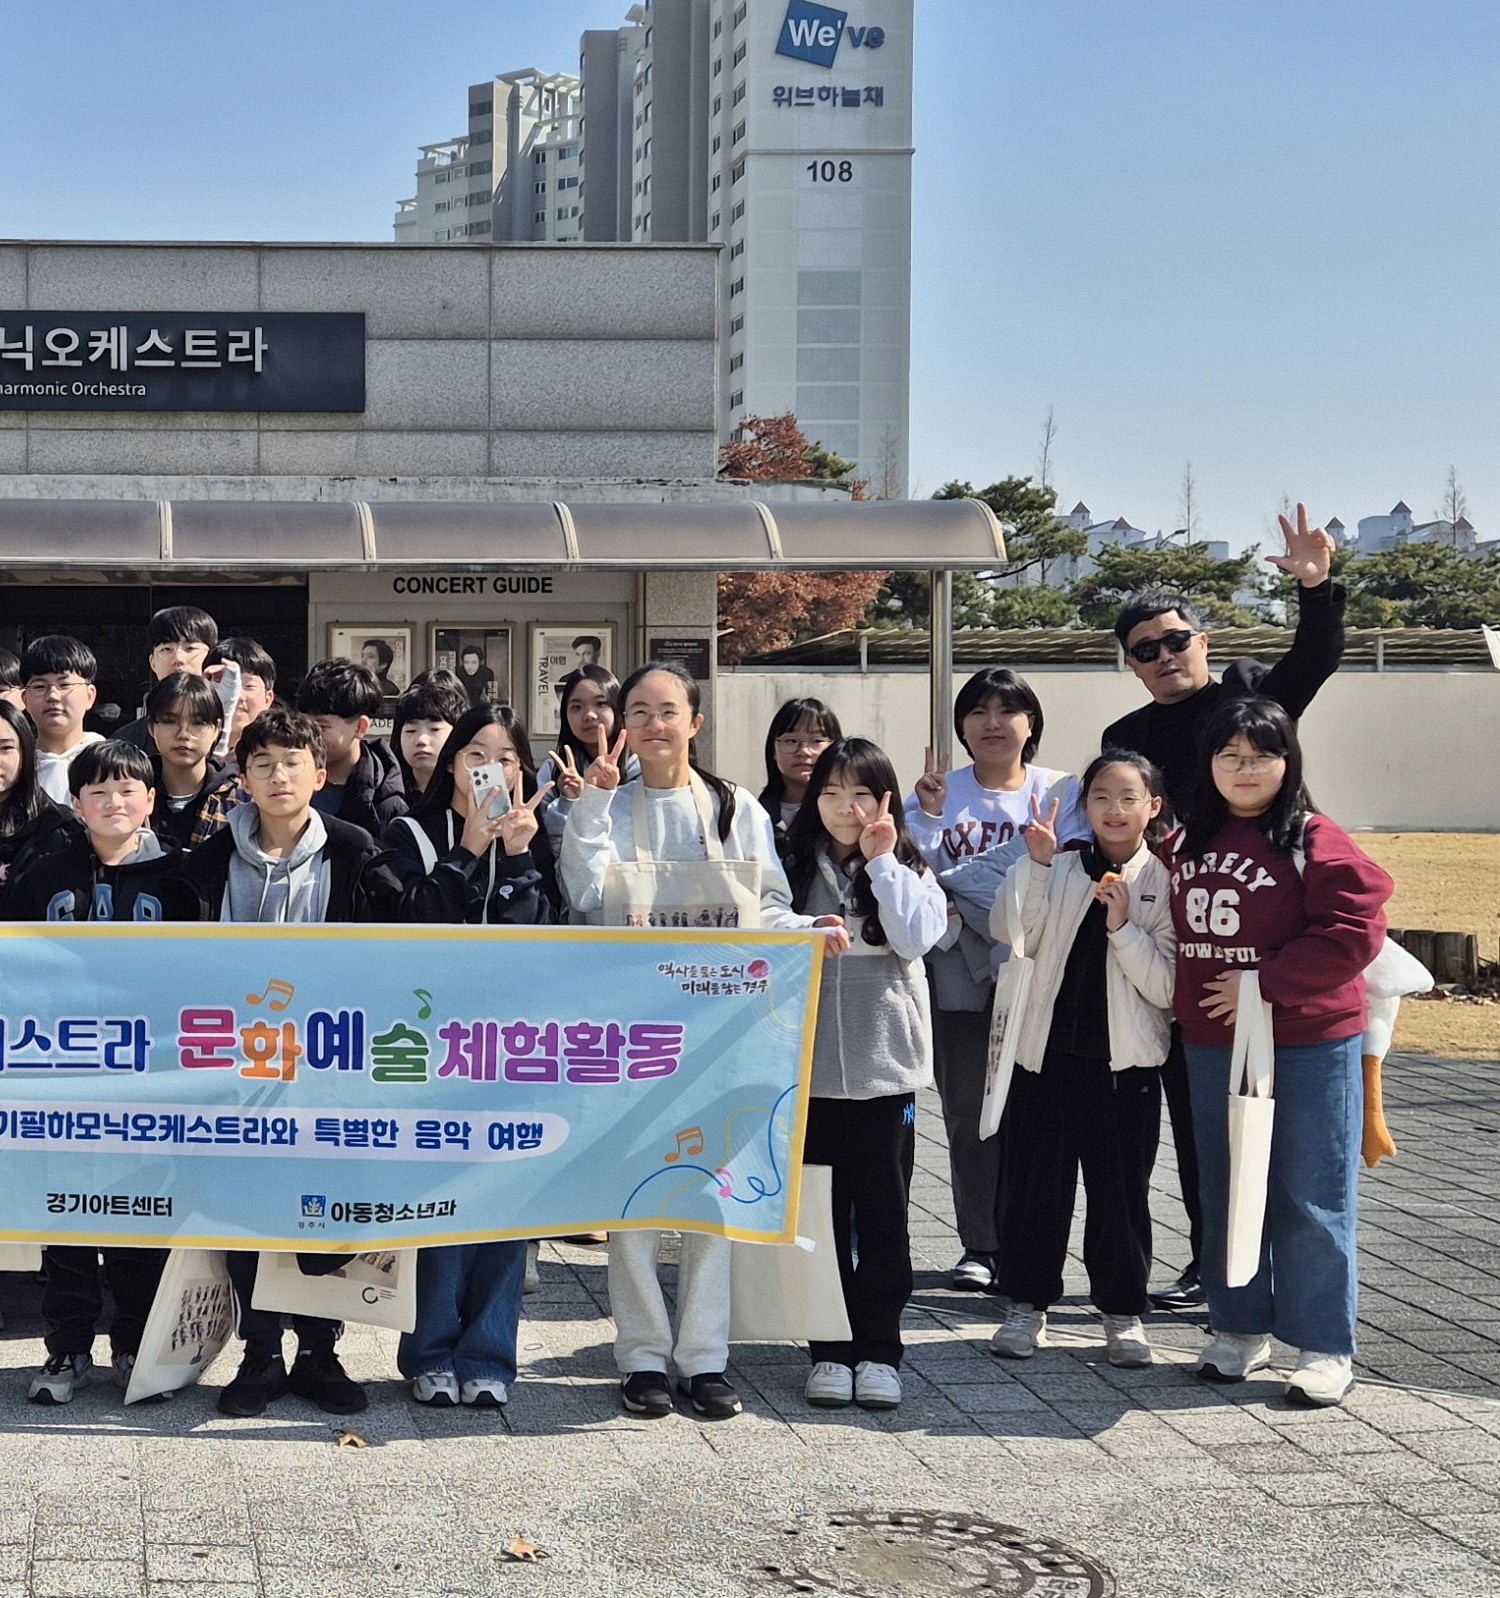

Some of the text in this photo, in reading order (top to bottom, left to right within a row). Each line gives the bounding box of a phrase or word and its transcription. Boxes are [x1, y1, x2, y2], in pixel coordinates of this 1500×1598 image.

[788, 19, 885, 48] We've
[806, 160, 854, 183] 108
[71, 381, 147, 396] Orchestra
[393, 577, 554, 594] CONCERT GUIDE
[538, 656, 548, 696] TRAVEL
[1172, 851, 1277, 895] PURELY
[1186, 887, 1240, 936] 86
[720, 964, 744, 978] 도시
[681, 980, 720, 995] 미래를
[314, 1118, 399, 1148] 특별한
[415, 1119, 472, 1150] 음악
[487, 1121, 543, 1151] 여행
[46, 1192, 173, 1217] 경기아트센터
[331, 1199, 457, 1223] 아동청소년과
